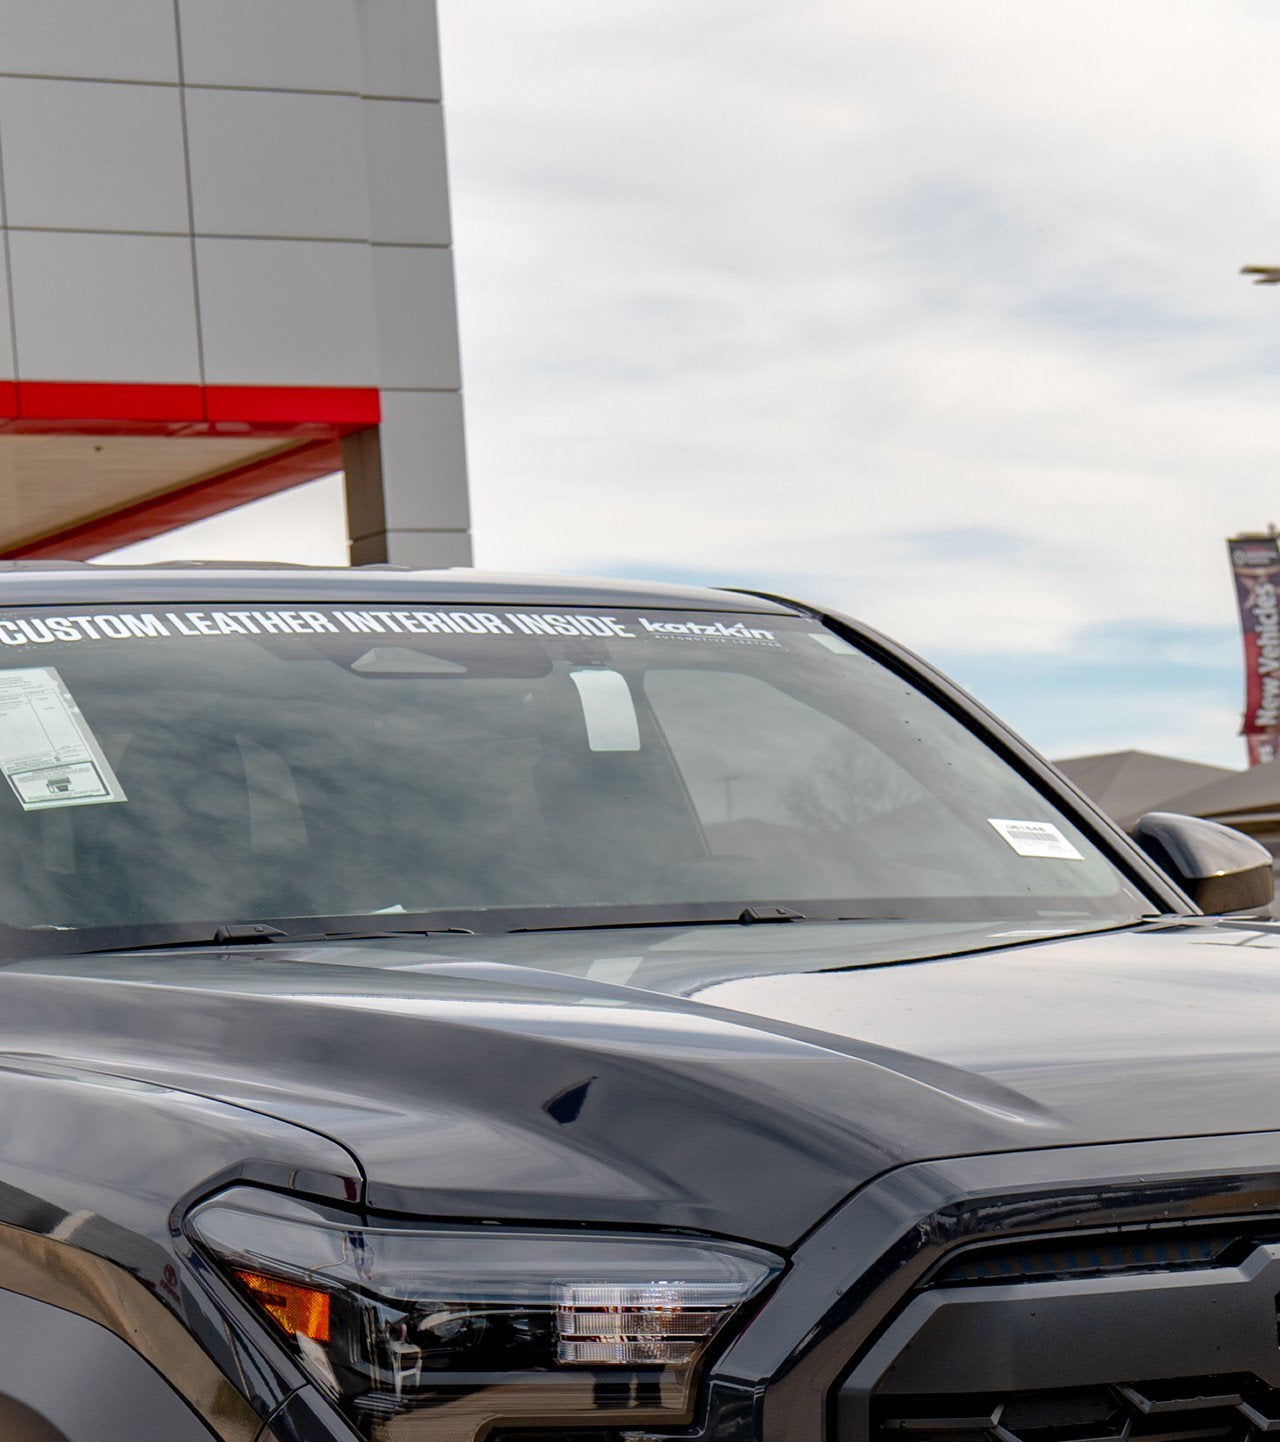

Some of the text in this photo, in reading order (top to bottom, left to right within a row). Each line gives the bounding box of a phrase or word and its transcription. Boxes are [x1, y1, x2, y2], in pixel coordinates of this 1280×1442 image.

[165, 610, 339, 636] LEATHER
[331, 610, 514, 635] INTERIOR
[505, 613, 636, 639] INSIDE
[638, 616, 775, 641] katzkin
